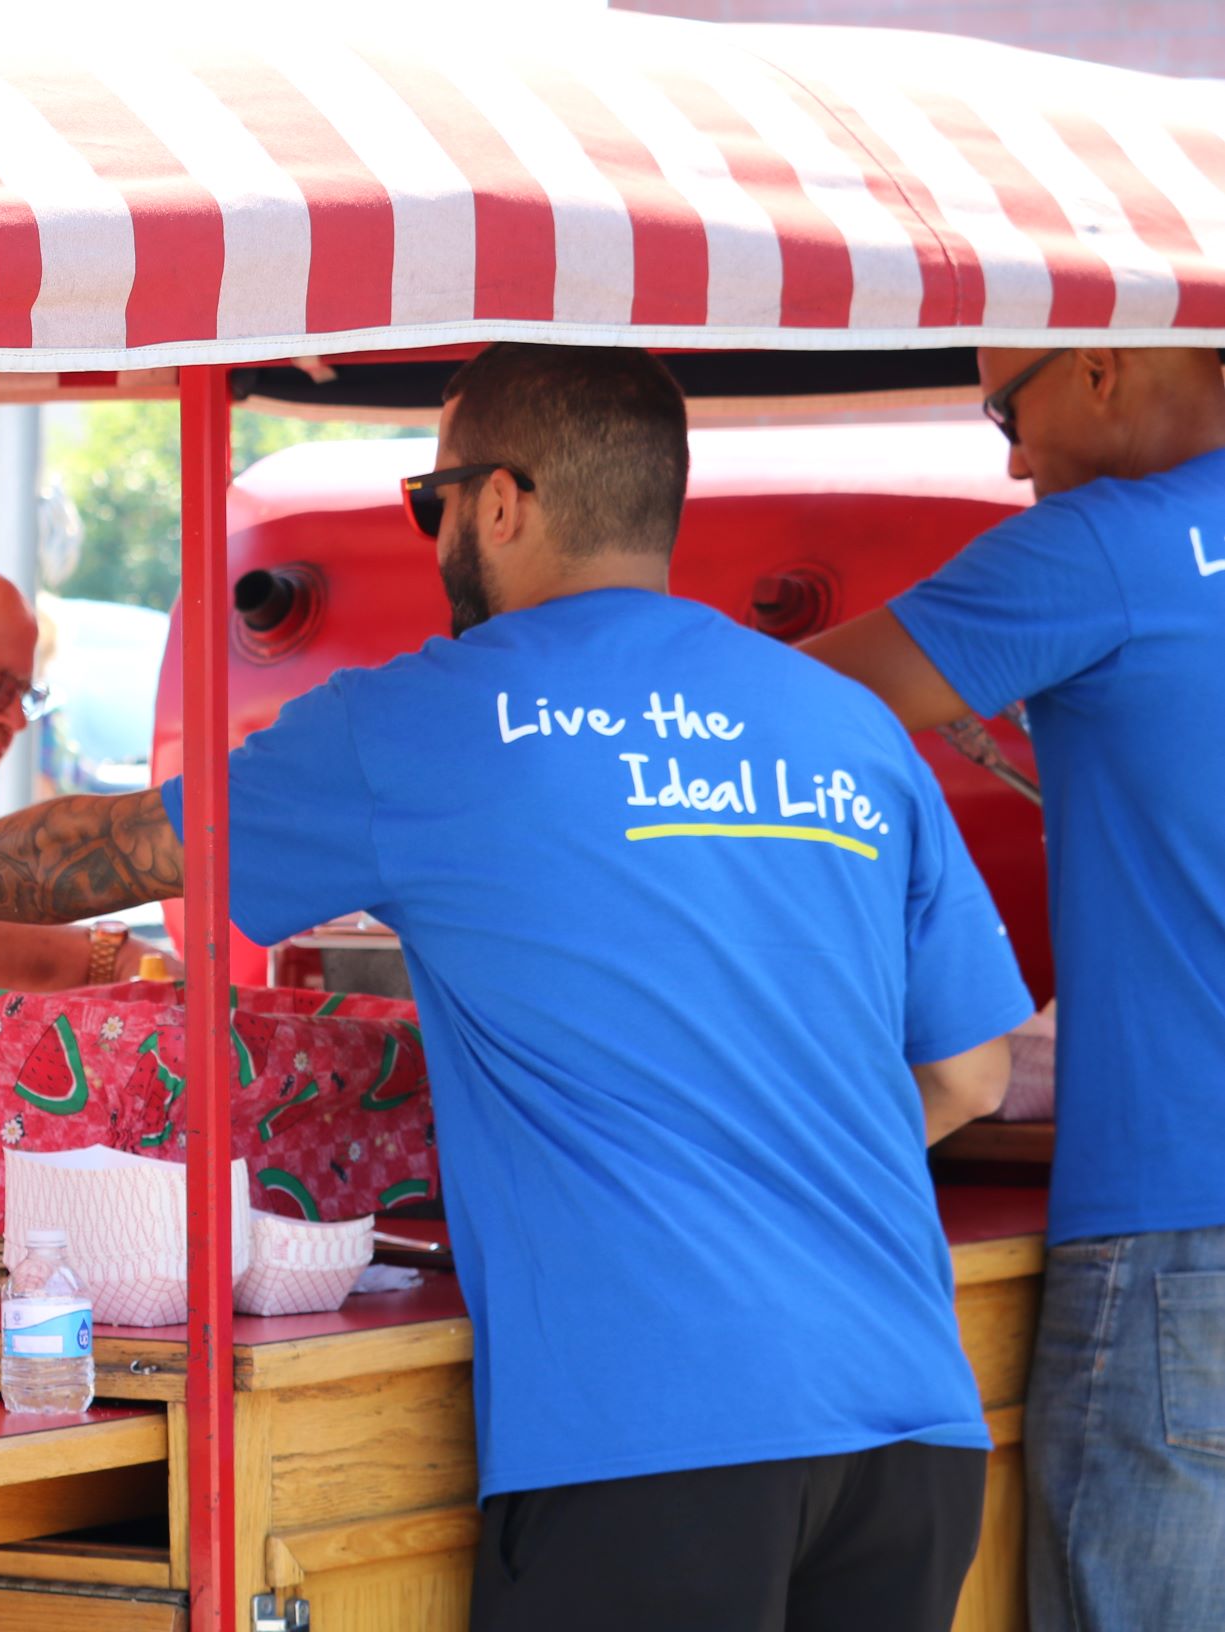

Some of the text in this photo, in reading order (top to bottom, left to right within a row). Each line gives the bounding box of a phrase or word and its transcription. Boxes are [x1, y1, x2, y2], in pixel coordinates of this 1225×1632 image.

[1189, 526, 1225, 577] L
[496, 691, 745, 744] Live the
[618, 752, 889, 835] Ideal Life.
